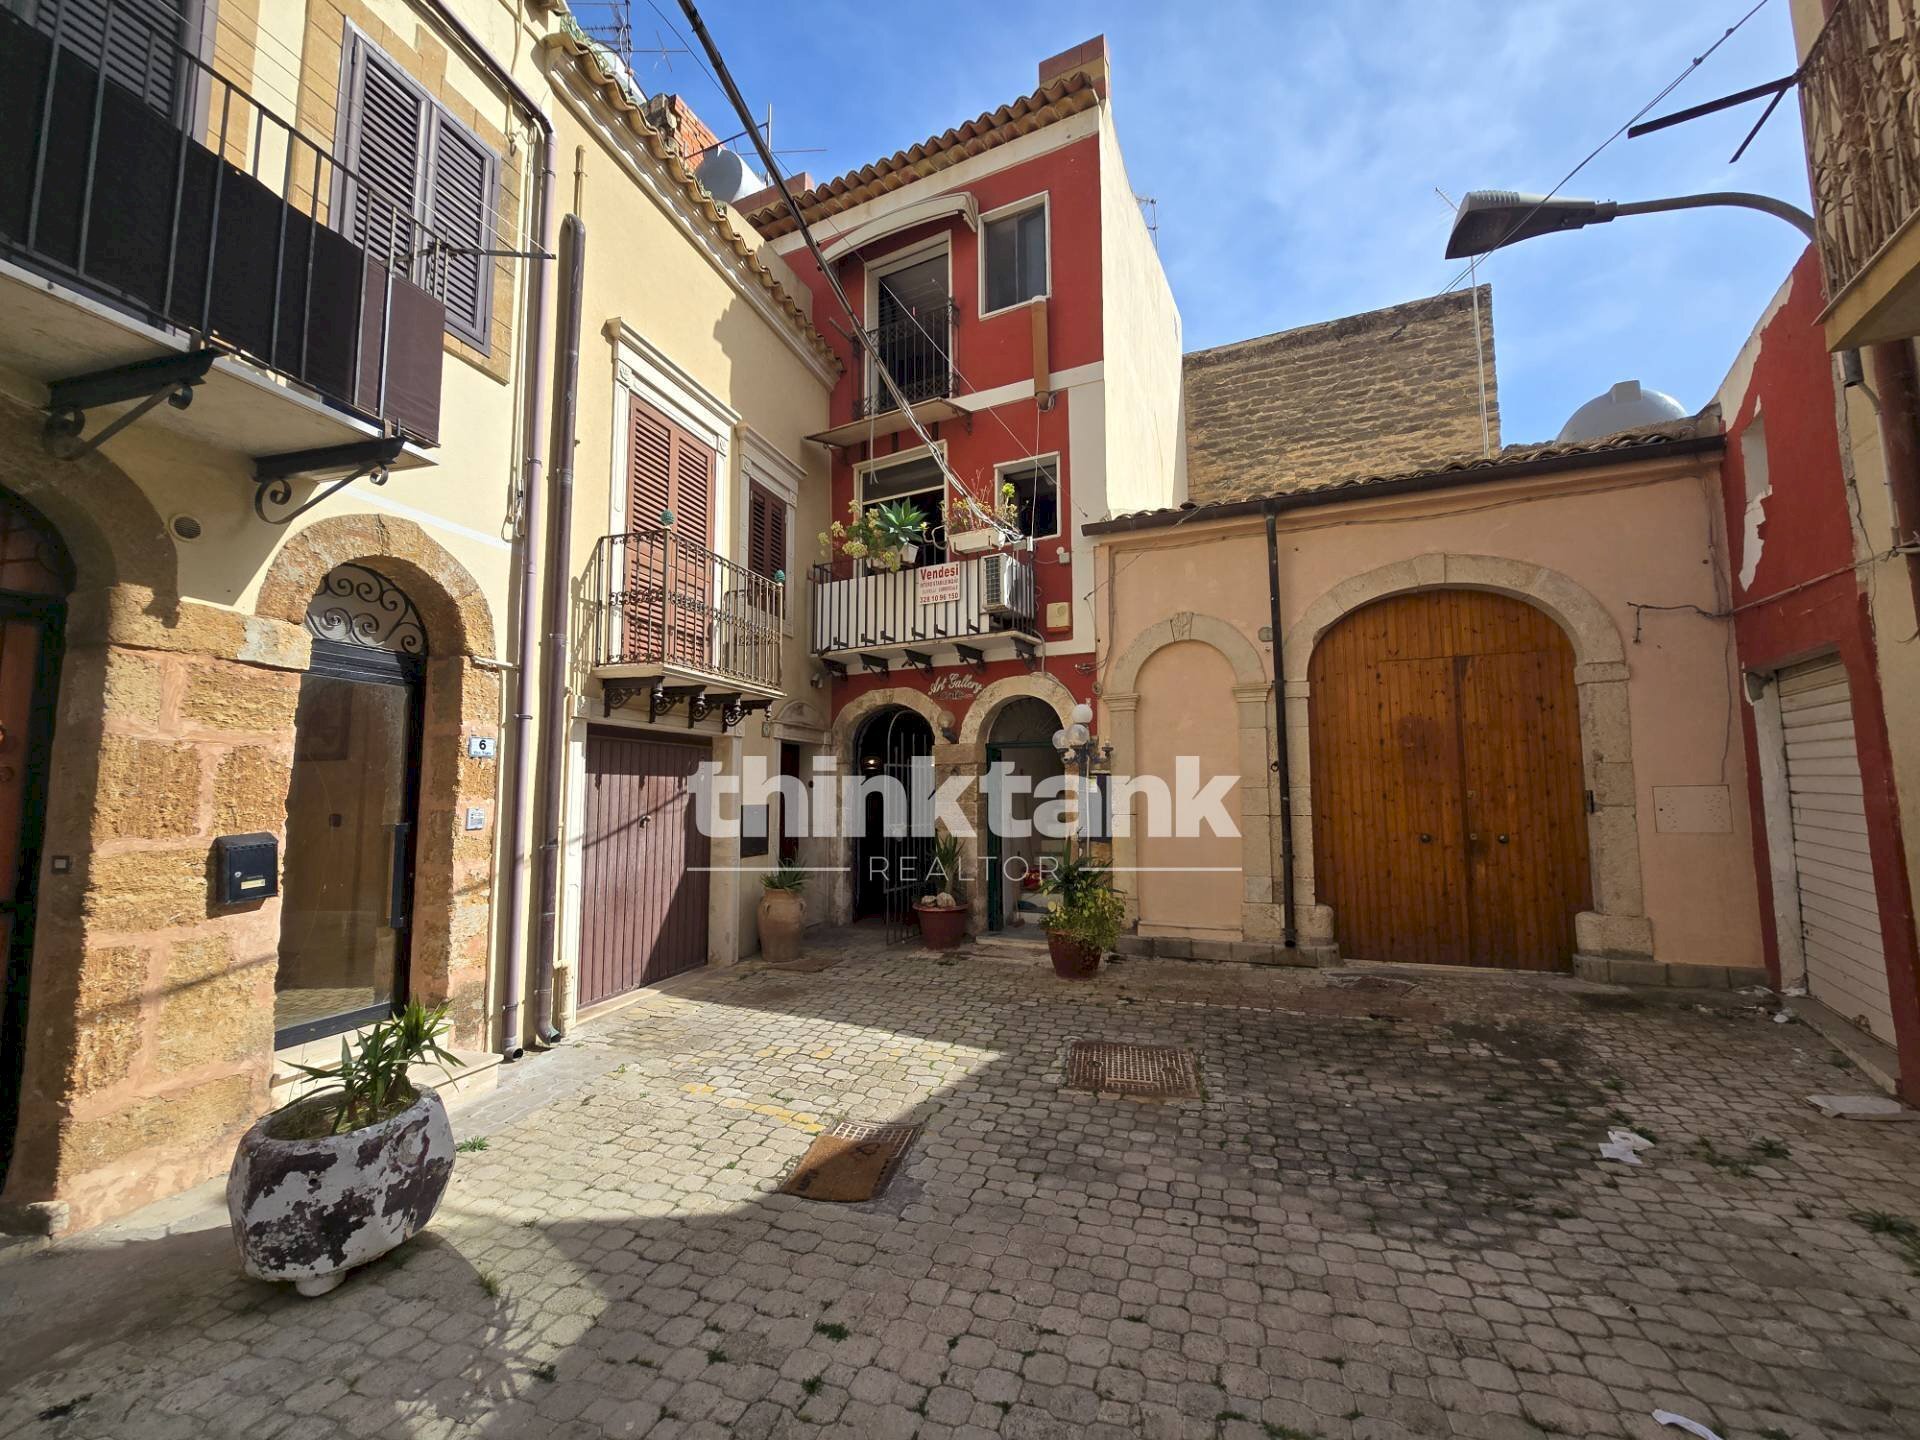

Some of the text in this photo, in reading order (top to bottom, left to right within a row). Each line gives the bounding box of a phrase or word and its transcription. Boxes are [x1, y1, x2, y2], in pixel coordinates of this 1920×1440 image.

[920, 564, 958, 580] Vendesi
[948, 673, 982, 694] Gallery
[479, 740, 486, 750] 6
